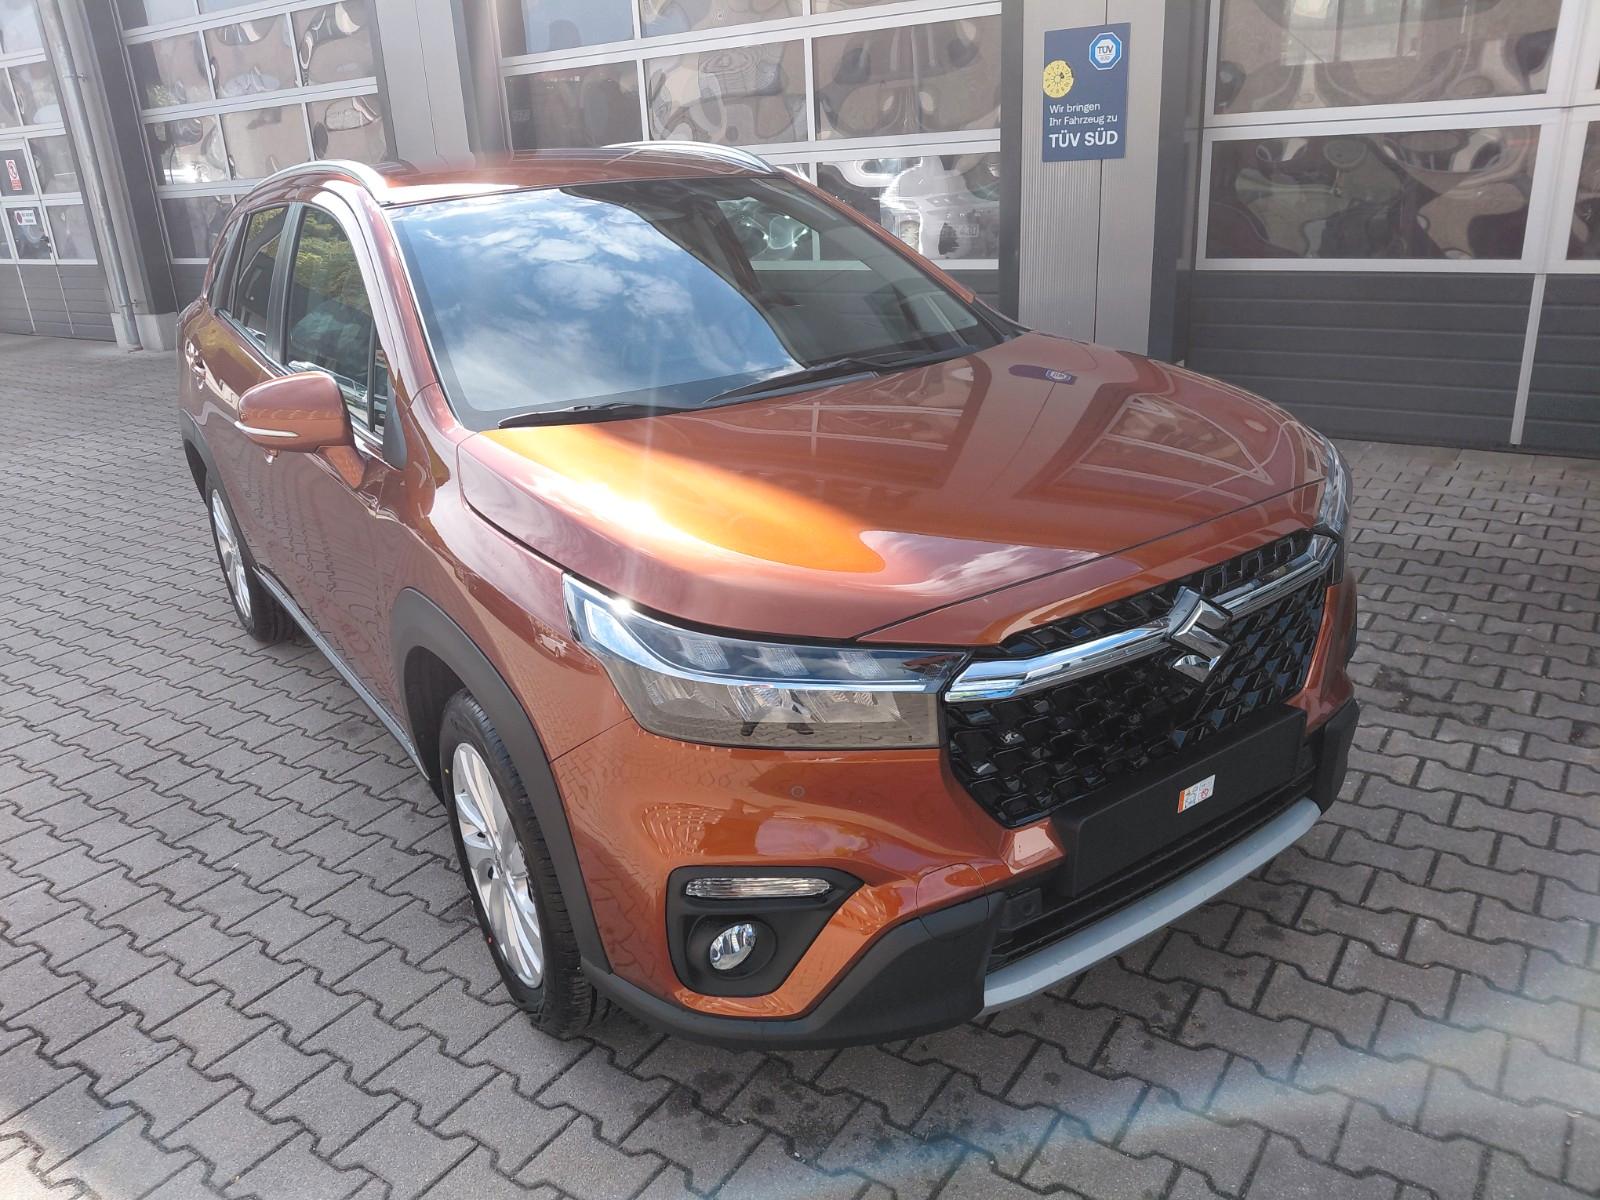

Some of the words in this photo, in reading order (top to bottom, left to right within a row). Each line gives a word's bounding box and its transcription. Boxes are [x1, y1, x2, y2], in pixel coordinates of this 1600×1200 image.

[1049, 104, 1064, 114] Wir
[1067, 103, 1100, 113] bringen
[1049, 117, 1062, 126] Ihr
[1064, 115, 1105, 125] Fahrzeug
[1106, 114, 1118, 123] zu
[1049, 129, 1081, 148] TÜV
[1084, 127, 1119, 146] SÜD
